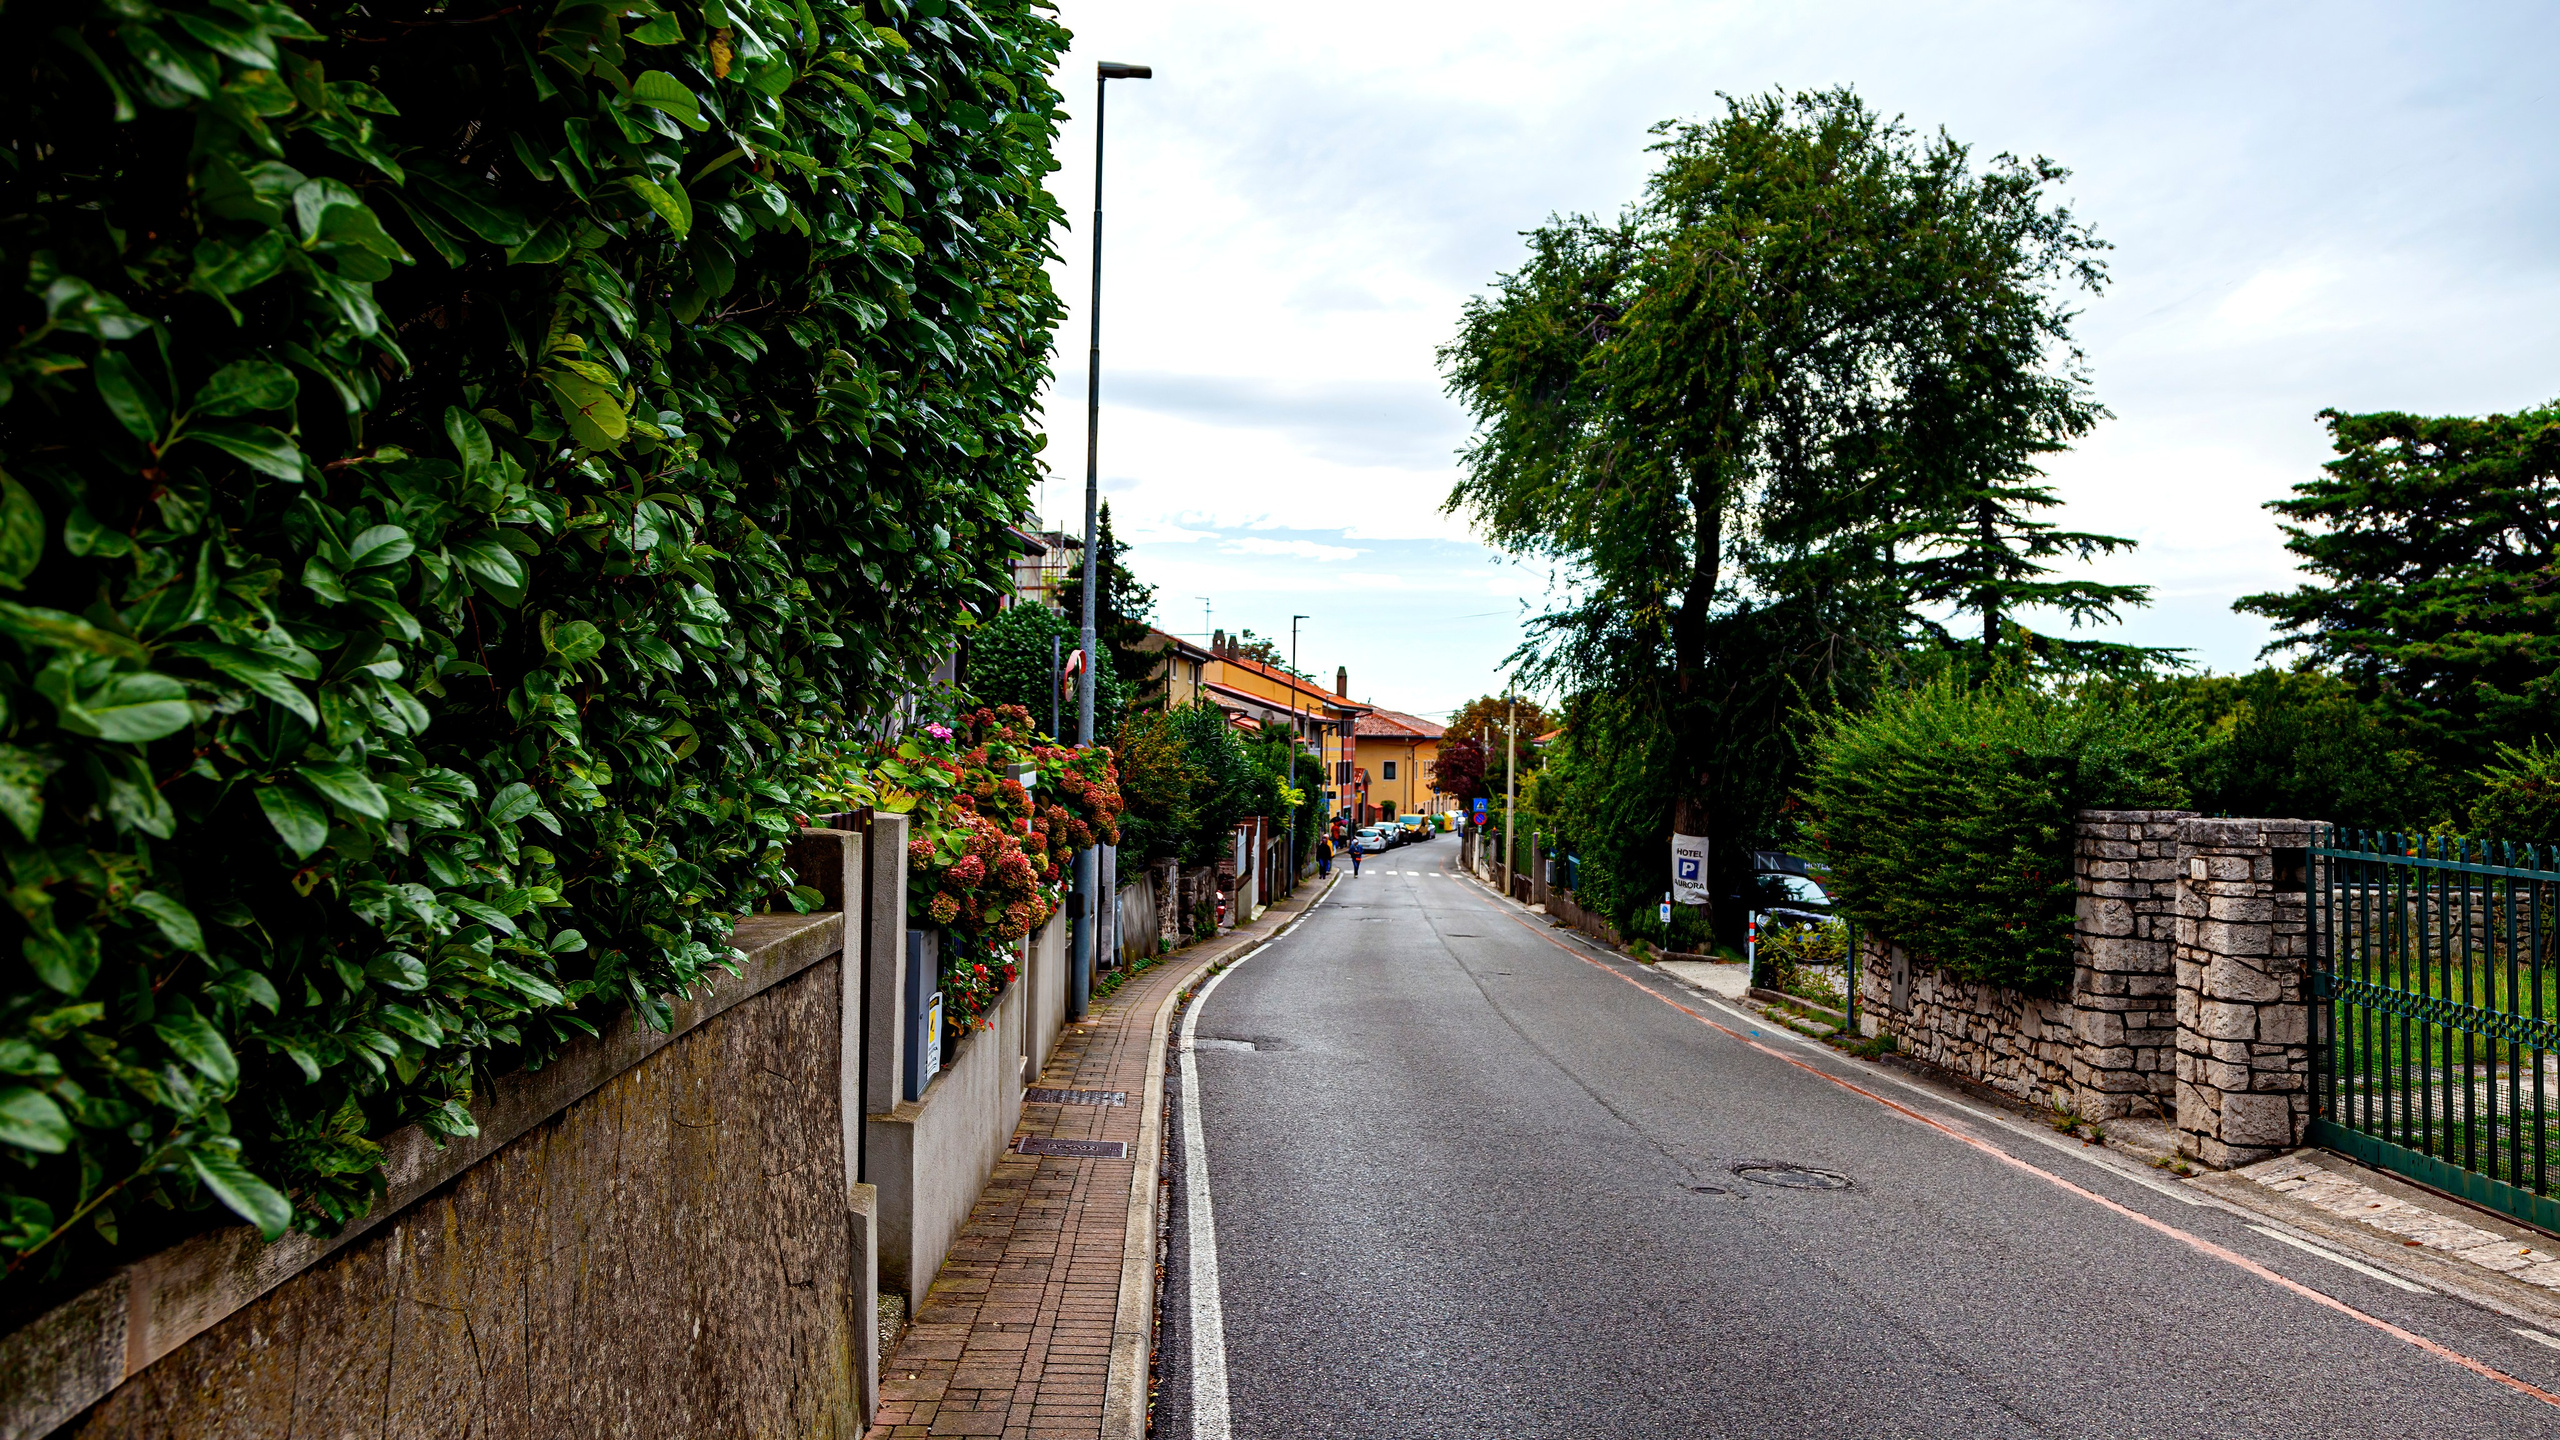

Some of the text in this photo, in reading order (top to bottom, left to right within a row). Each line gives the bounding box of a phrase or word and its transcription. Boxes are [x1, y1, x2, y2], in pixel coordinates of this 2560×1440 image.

[1676, 847, 1703, 858] HOTEL
[1681, 861, 1695, 876] P
[1674, 878, 1705, 889] AURORA
